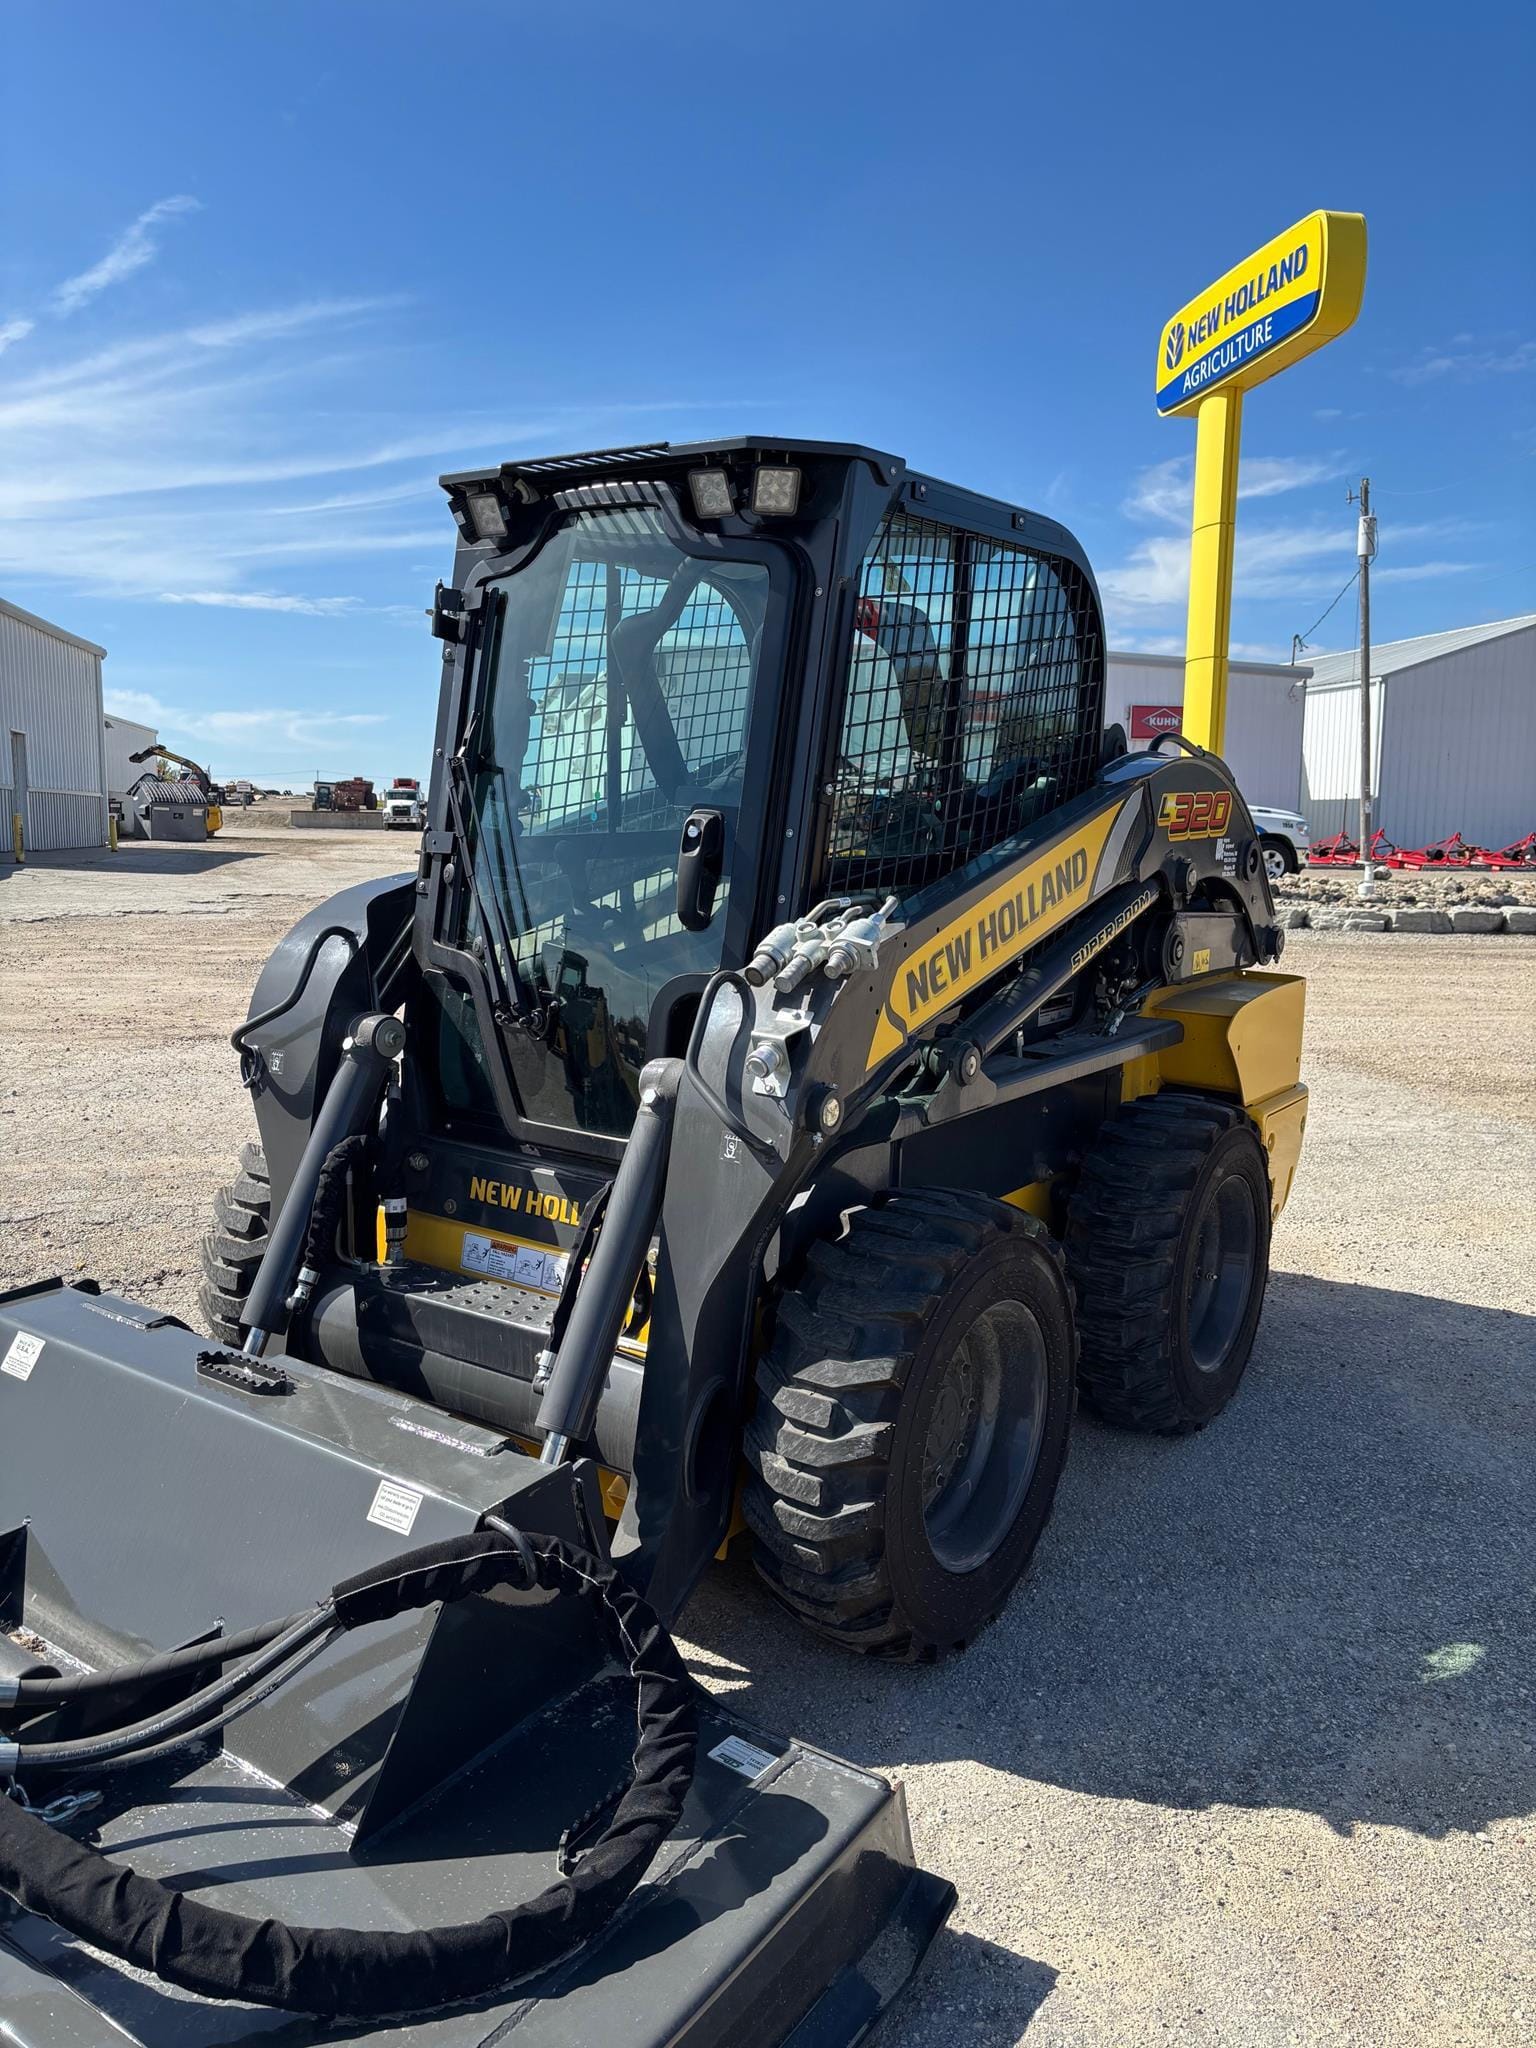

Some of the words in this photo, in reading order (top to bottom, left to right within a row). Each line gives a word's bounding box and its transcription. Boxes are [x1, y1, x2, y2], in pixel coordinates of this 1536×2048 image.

[1187, 303, 1222, 352] NEW
[1223, 243, 1308, 326] HOLLAND
[1182, 317, 1273, 394] AGRICULTURE
[1149, 717, 1179, 727] KUHN
[1158, 791, 1232, 841] L320
[906, 928, 972, 1016] NEW
[977, 847, 1088, 961] HOLLAND
[1071, 921, 1116, 969] SUPER
[1115, 890, 1150, 929] BOOM
[469, 1176, 522, 1211] NEW
[525, 1190, 580, 1226] HOLL
